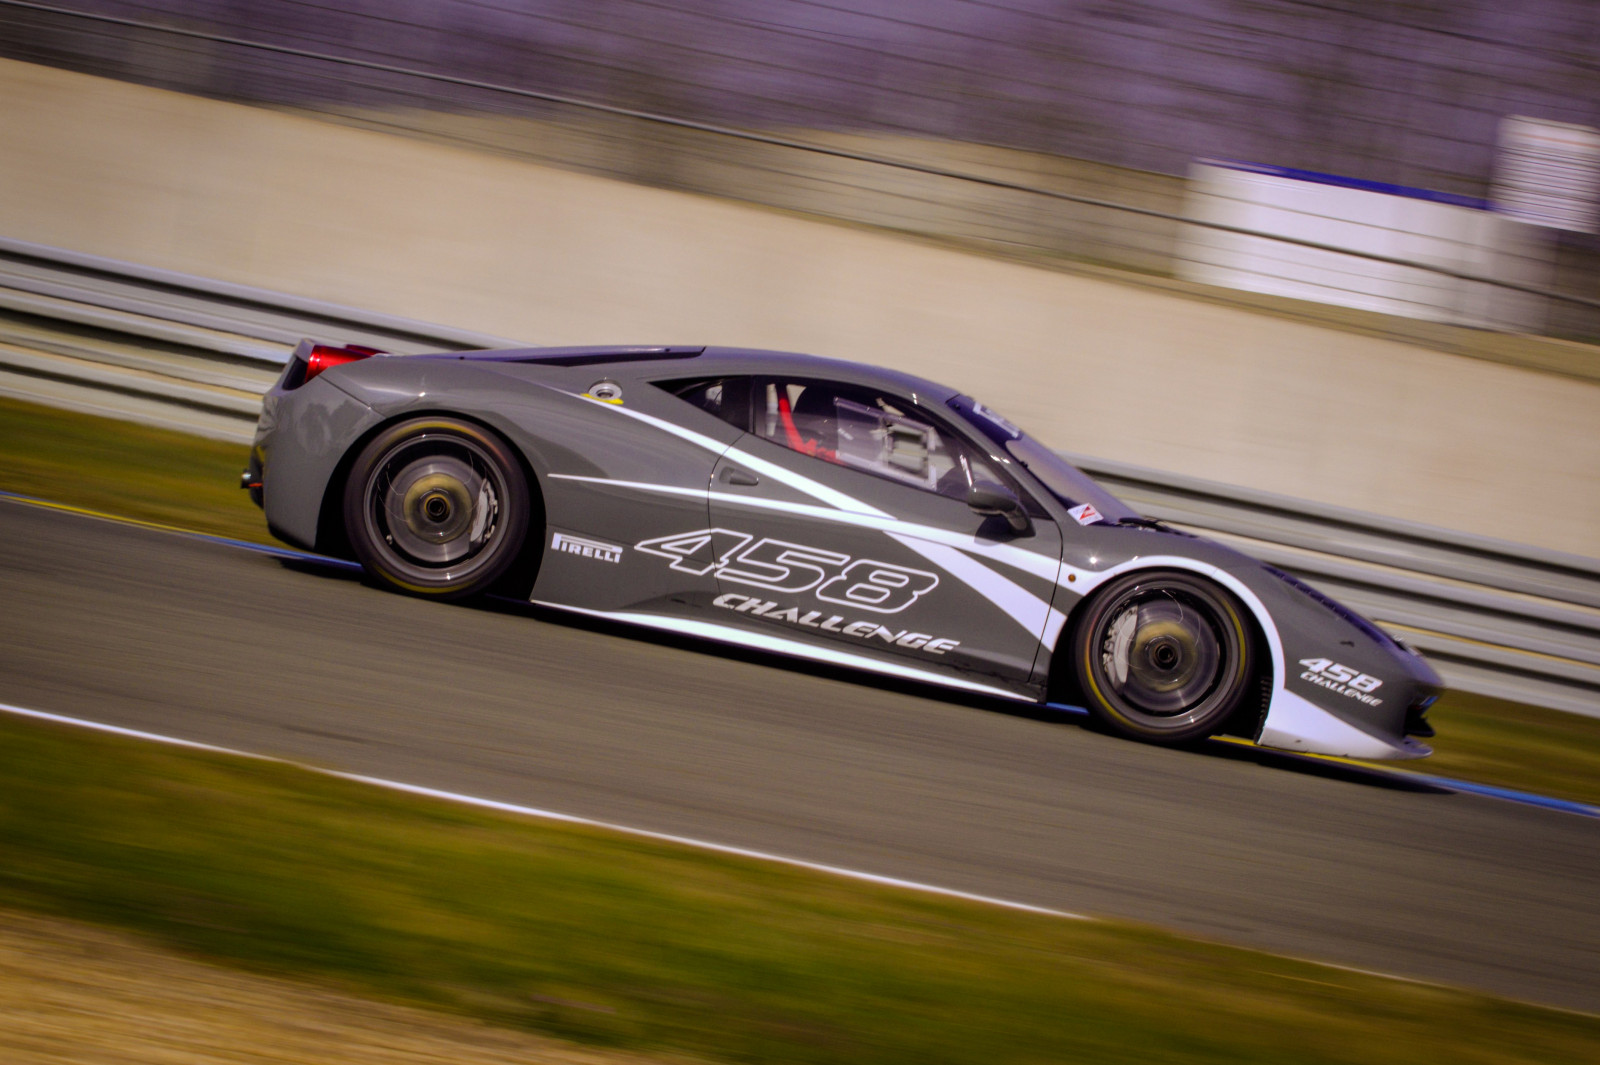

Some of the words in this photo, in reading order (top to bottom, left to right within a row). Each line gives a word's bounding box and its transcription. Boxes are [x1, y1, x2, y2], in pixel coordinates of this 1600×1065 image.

[551, 533, 623, 563] PIRELLI
[634, 528, 939, 614] 458
[712, 593, 960, 654] CHALLENGE
[1299, 657, 1383, 693] 458
[1300, 671, 1383, 707] CHALLENGE
